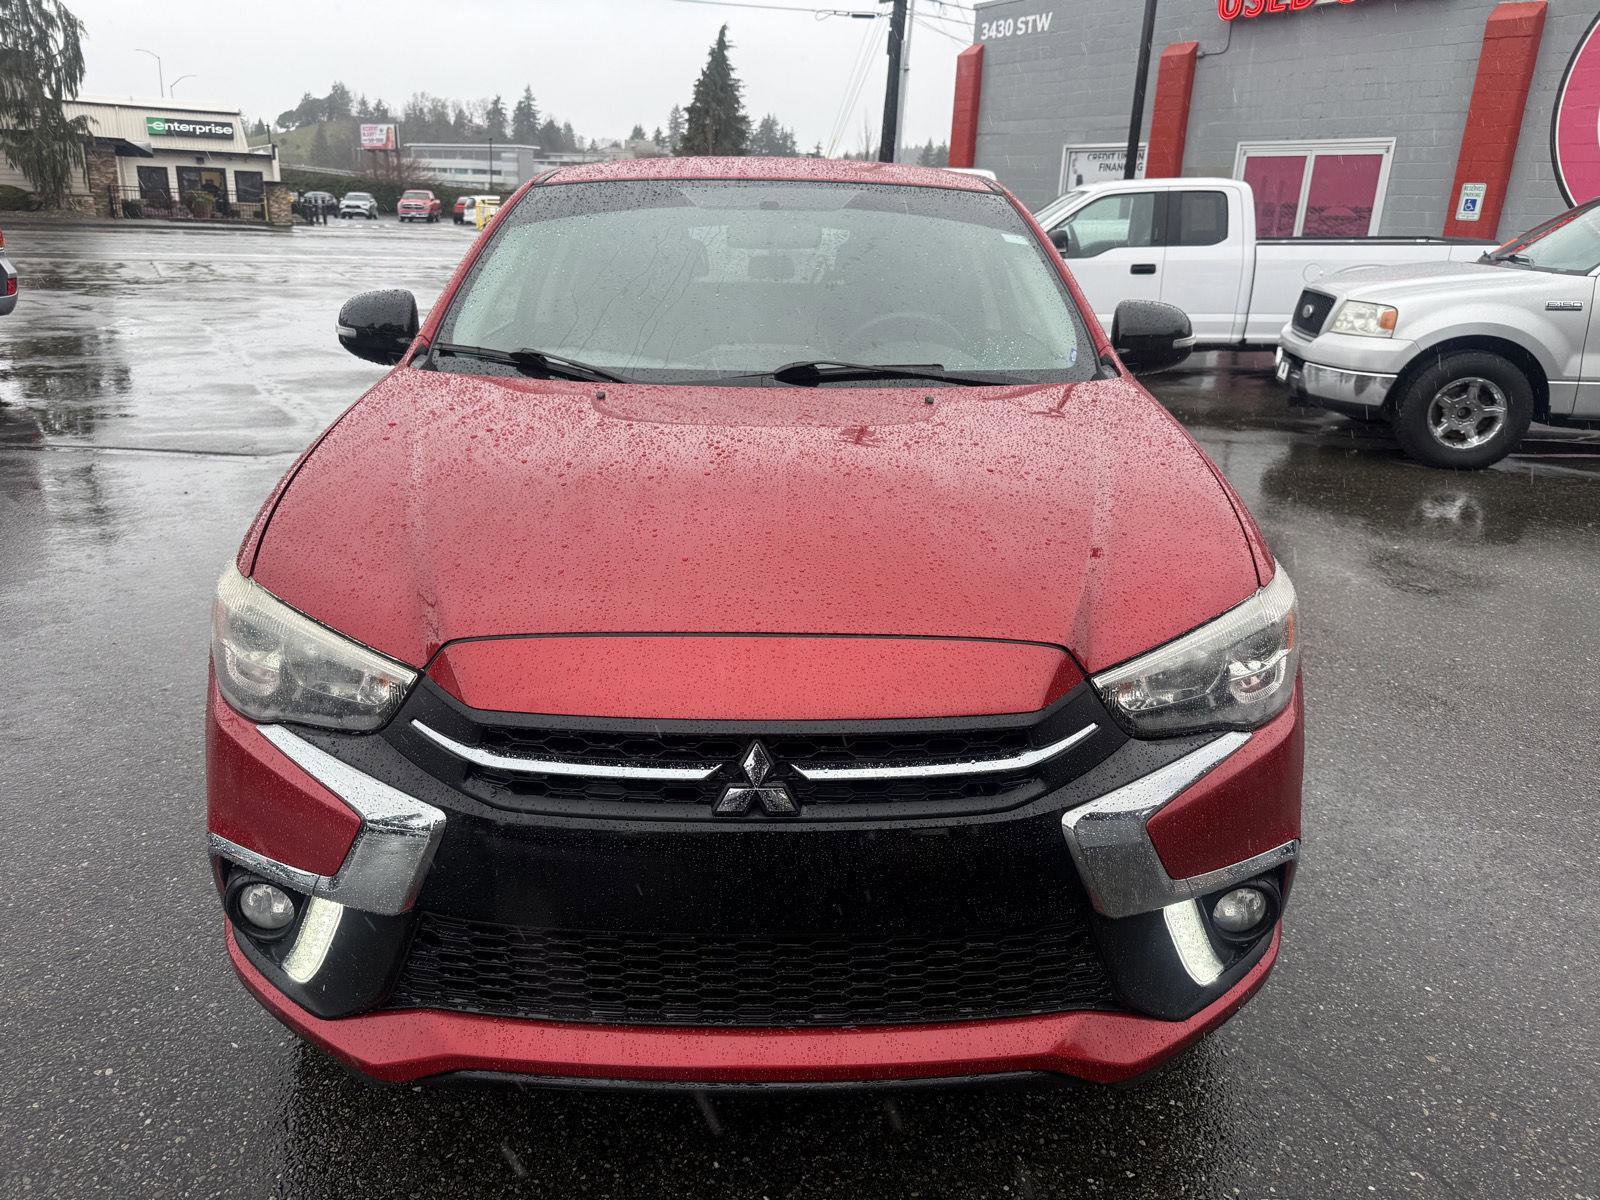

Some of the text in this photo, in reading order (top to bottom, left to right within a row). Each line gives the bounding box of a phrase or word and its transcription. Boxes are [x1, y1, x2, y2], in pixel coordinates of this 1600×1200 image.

[981, 11, 1053, 40] 3430 STW
[148, 121, 233, 134] enterprise
[1117, 151, 1144, 161] UNN
[1098, 162, 1143, 172] FINANG
